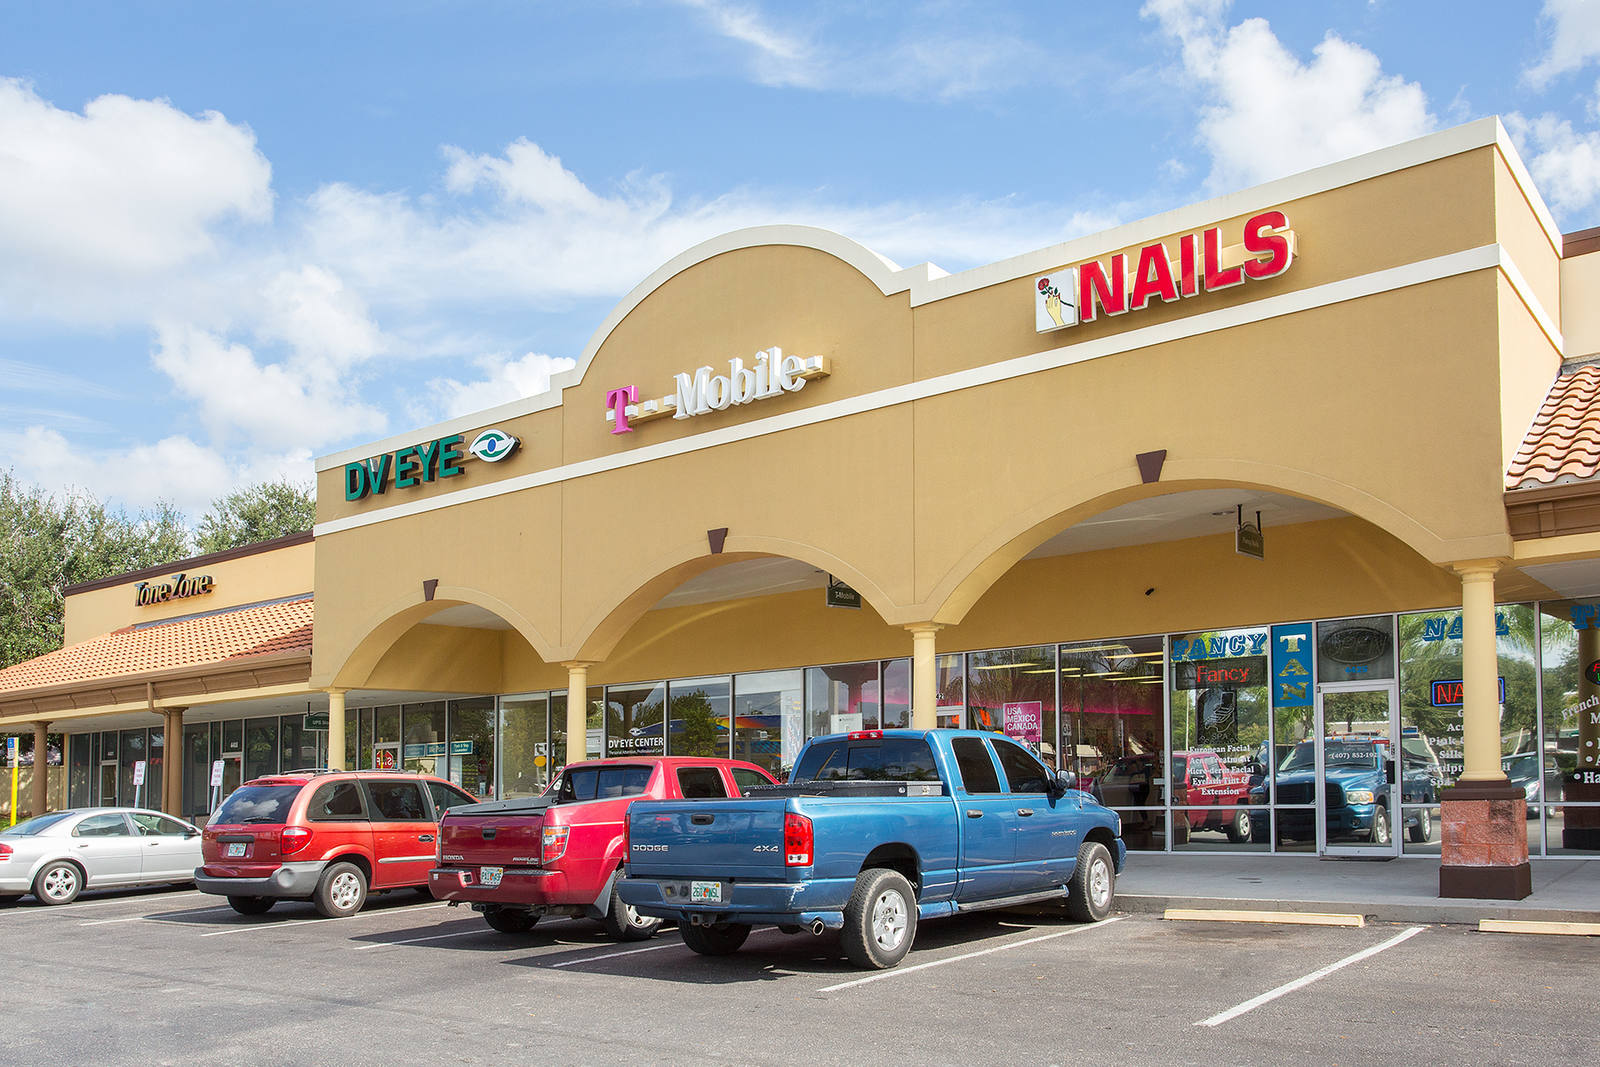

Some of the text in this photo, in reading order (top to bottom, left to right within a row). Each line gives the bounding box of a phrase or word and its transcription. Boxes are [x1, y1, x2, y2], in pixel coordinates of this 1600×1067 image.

[1079, 210, 1292, 323] NAILS
[345, 434, 467, 502] DV EYE
[134, 573, 213, 607] Tone Zone
[1170, 633, 1267, 661] FANCY
[1197, 665, 1250, 683] Fancy
[1278, 633, 1309, 700] TAN
[1561, 694, 1600, 720] French
[1007, 714, 1036, 722] MEXICO
[1007, 722, 1038, 730] CANADA
[620, 738, 633, 748] EYE
[634, 737, 664, 747] CENTER
[1227, 744, 1250, 752] Facial
[1232, 765, 1254, 773] Facial
[1201, 786, 1239, 795] Extension
